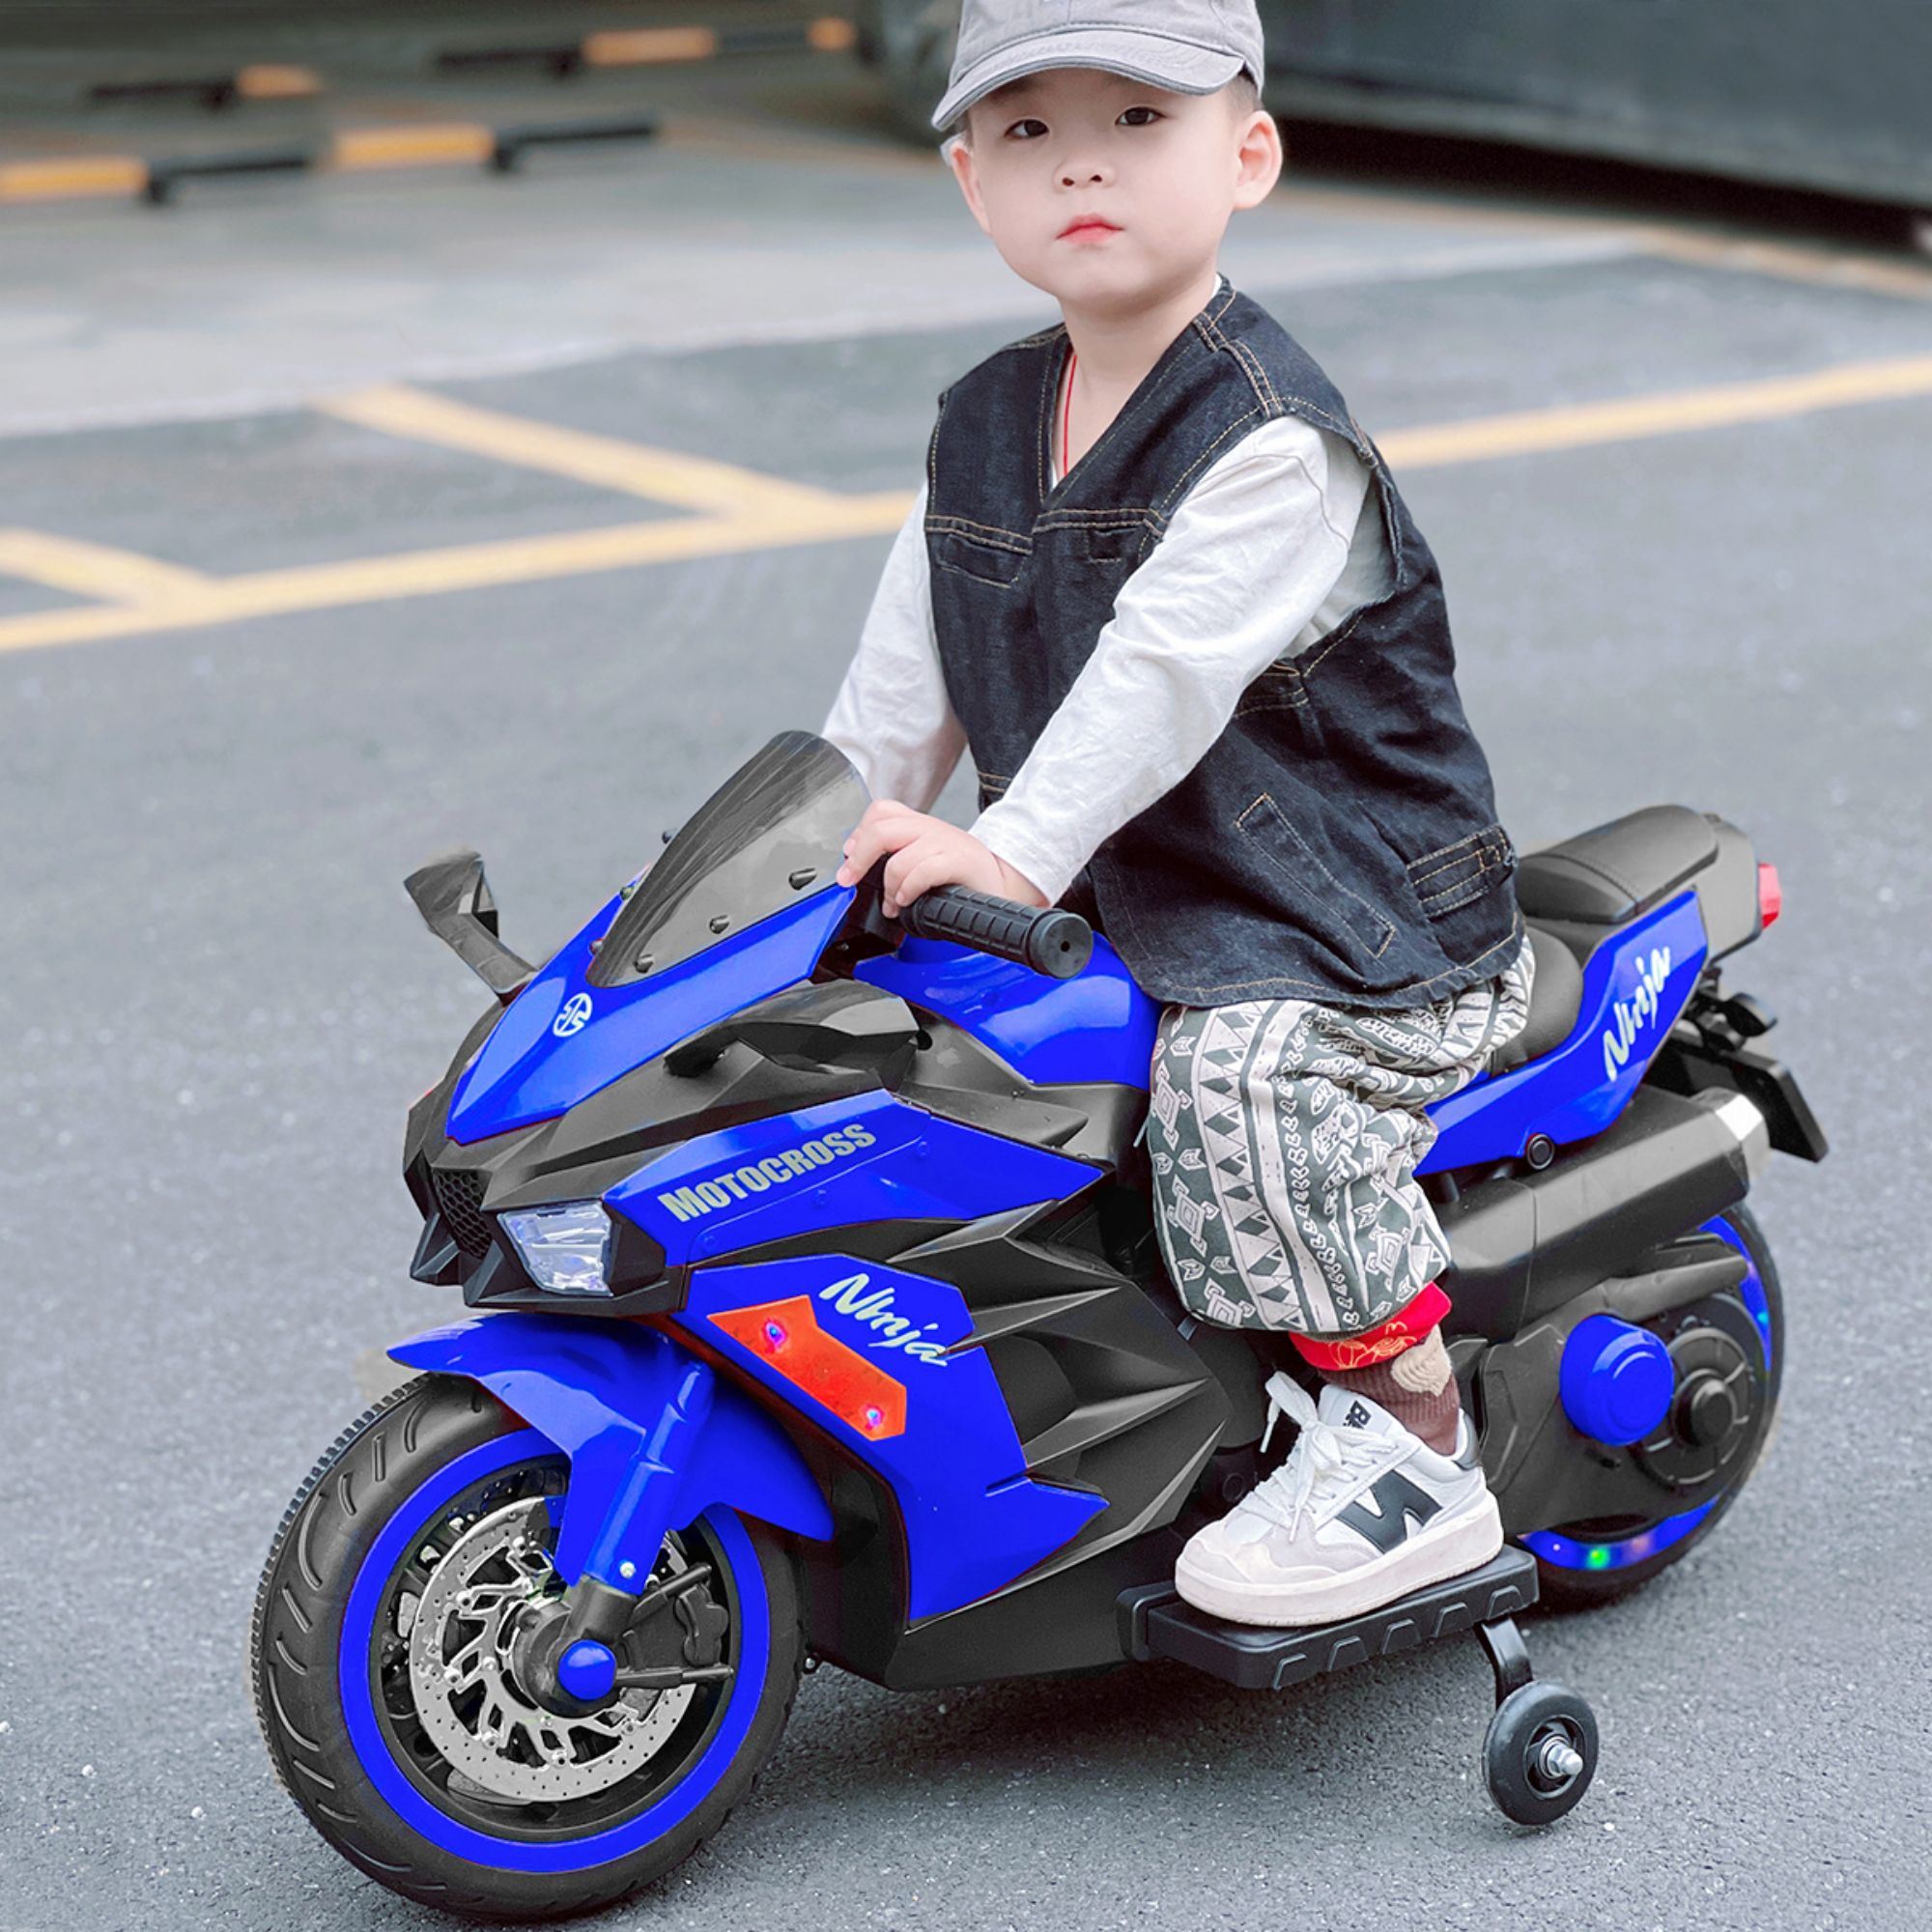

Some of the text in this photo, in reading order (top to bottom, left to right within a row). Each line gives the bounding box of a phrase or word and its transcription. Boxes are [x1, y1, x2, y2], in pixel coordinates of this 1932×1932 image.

[1603, 946, 1670, 1082] Ninja
[657, 1123, 876, 1222] MOTOCROSS
[819, 1273, 948, 1367] Ninja
